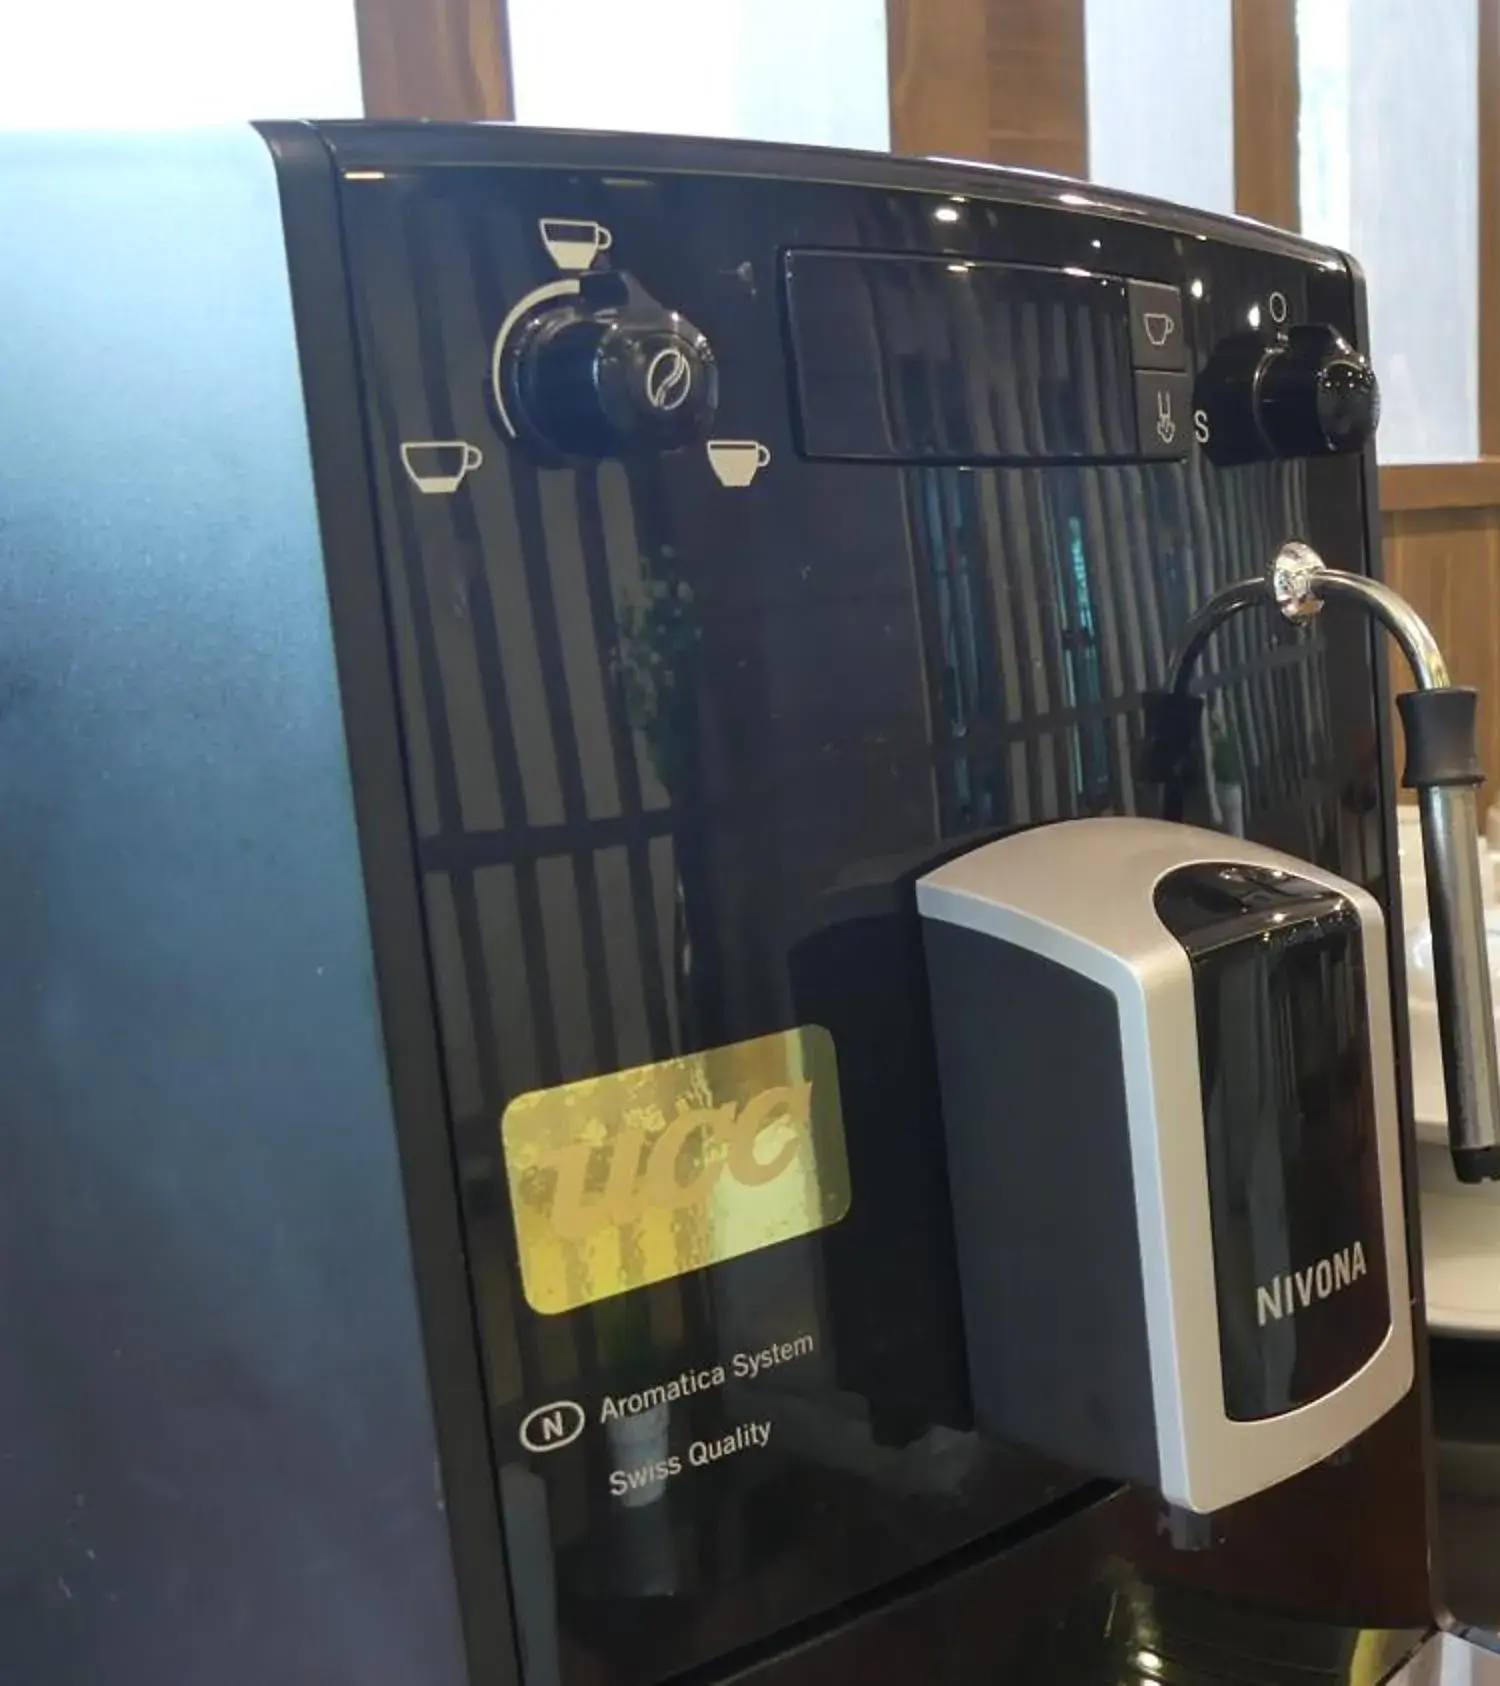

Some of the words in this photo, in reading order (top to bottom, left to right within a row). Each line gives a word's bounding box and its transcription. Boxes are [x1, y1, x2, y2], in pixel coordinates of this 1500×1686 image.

[1194, 410, 1210, 443] S
[1256, 1240, 1367, 1327] NIVONA
[600, 1364, 726, 1424] Aromatica
[733, 1332, 814, 1380] System
[609, 1454, 683, 1497] Swiss
[688, 1419, 773, 1468] Quality
